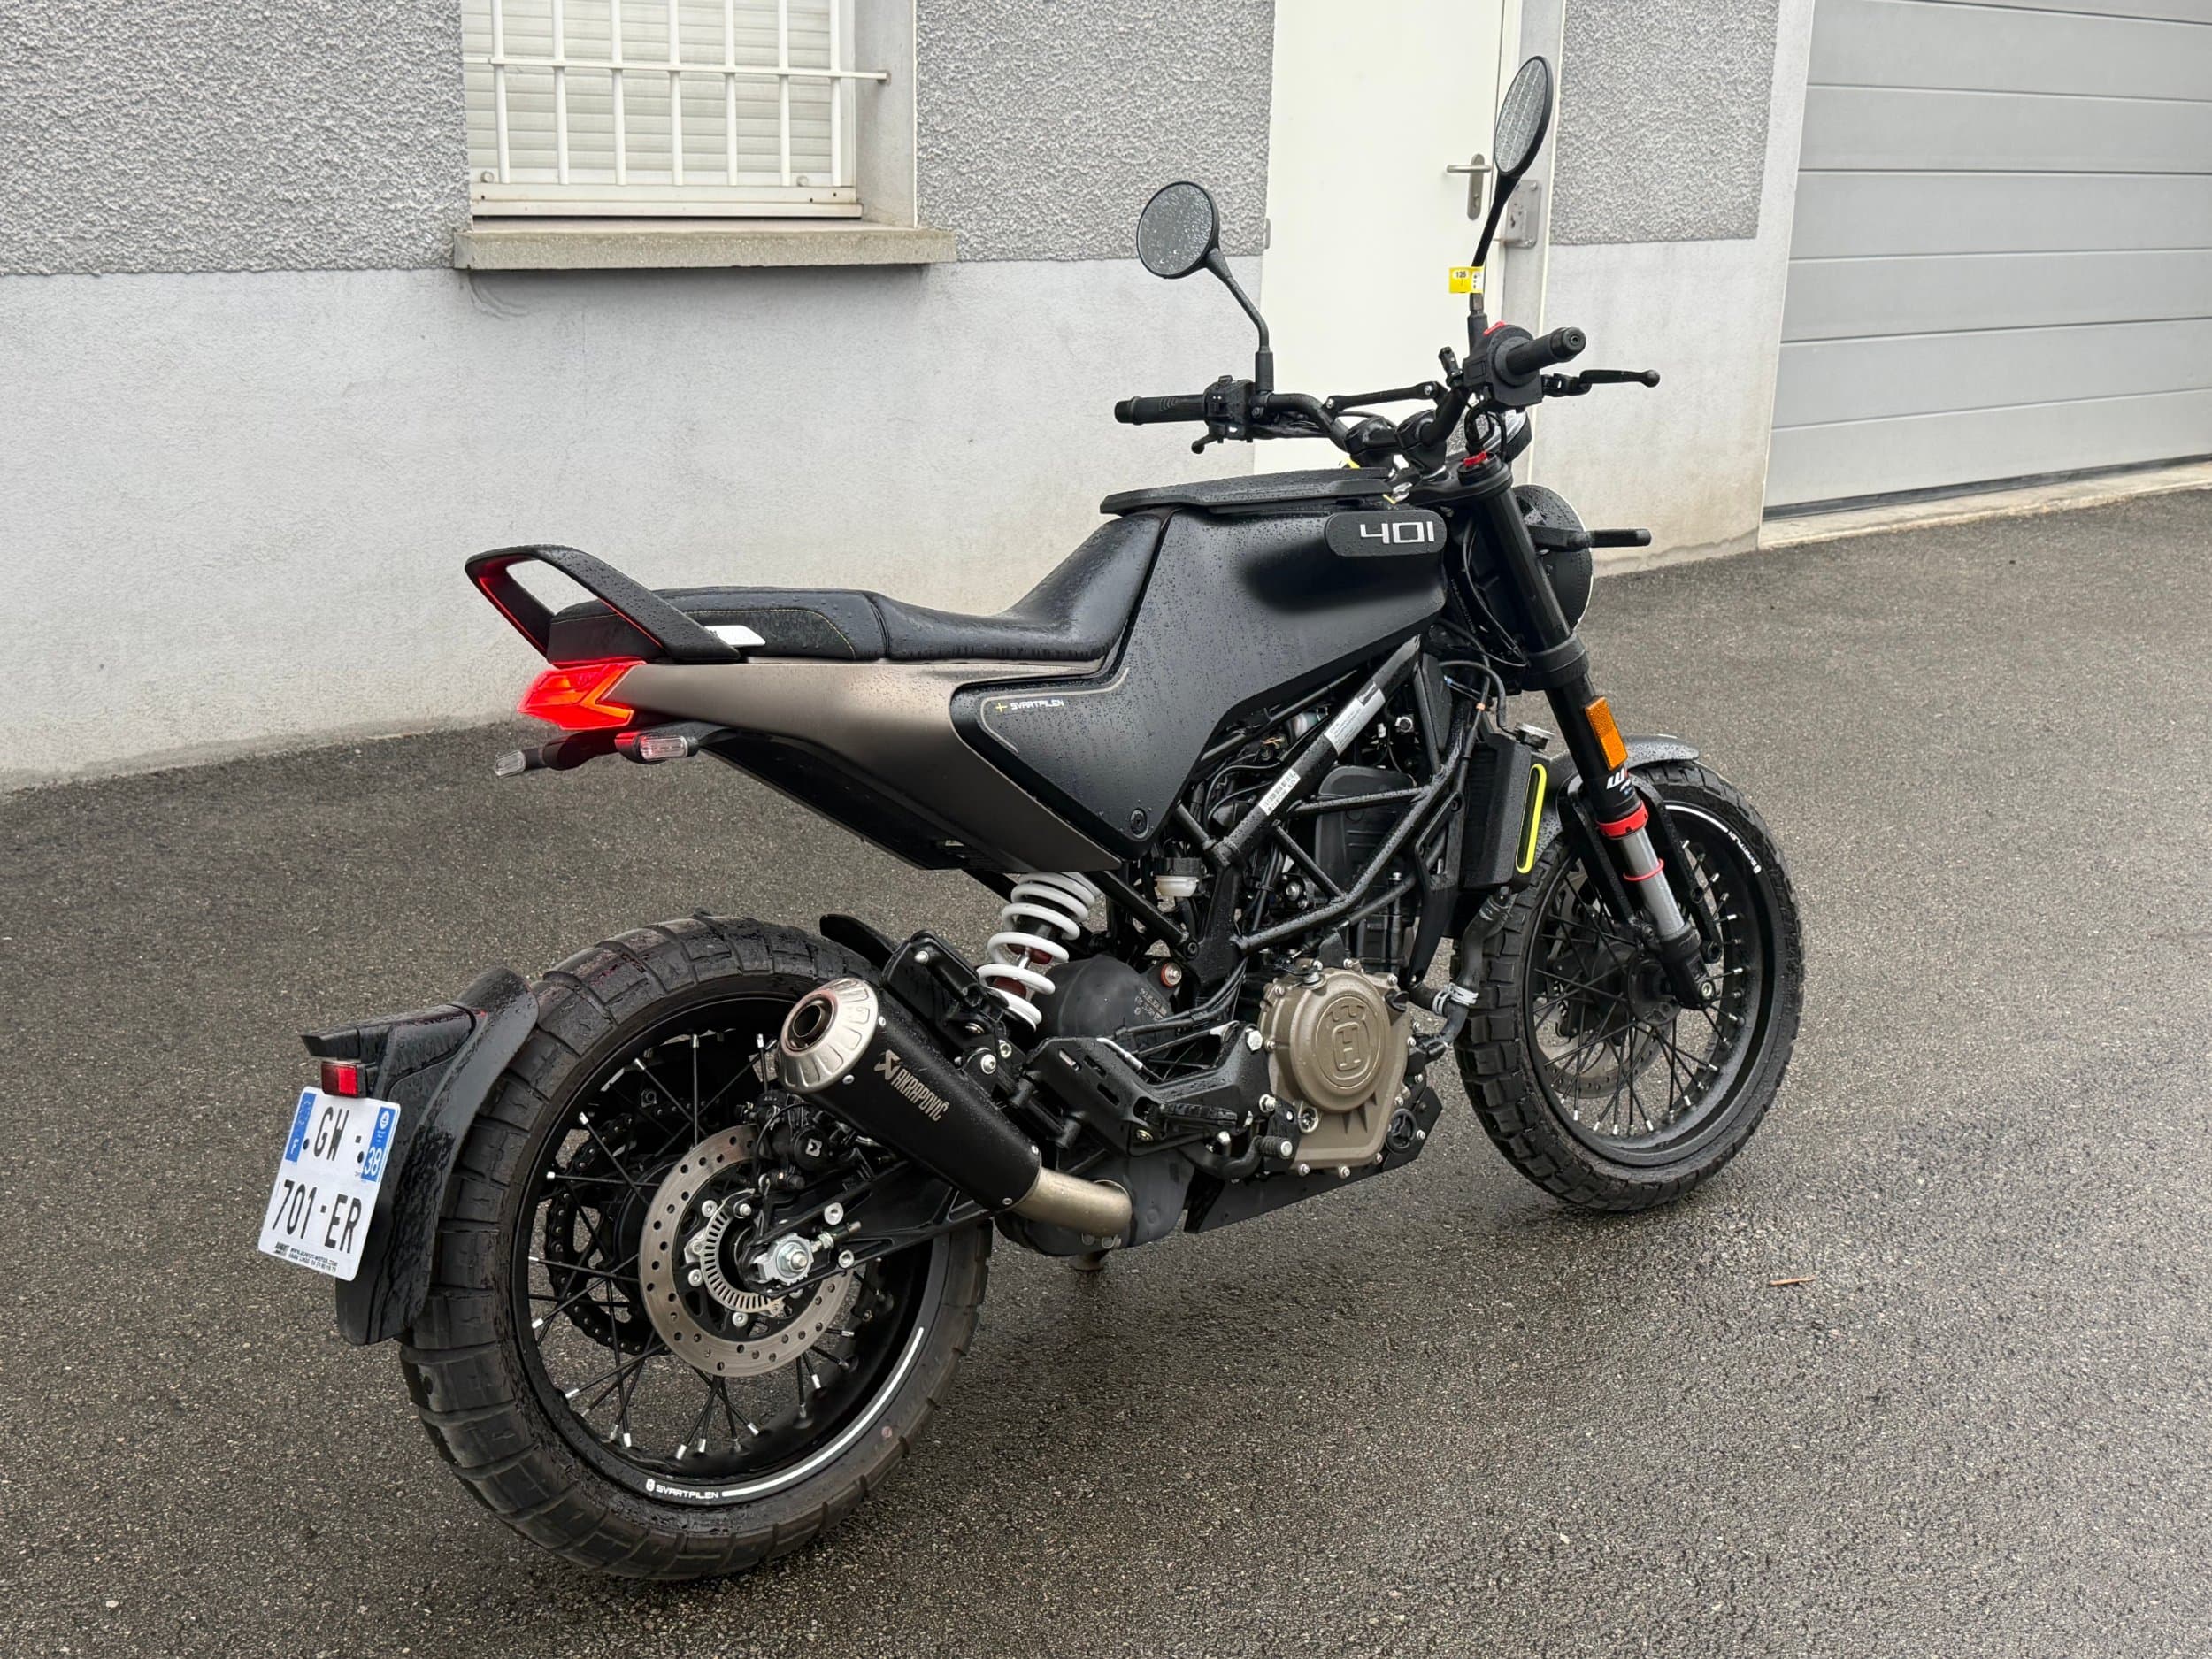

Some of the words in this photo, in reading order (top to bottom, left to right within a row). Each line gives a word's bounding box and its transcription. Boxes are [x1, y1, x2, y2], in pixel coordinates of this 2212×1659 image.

[1360, 521, 1435, 544] 401
[1010, 699, 1064, 710] SVARTPILEN
[364, 1147, 382, 1177] 38
[656, 1484, 719, 1499] SVARTPILEN
